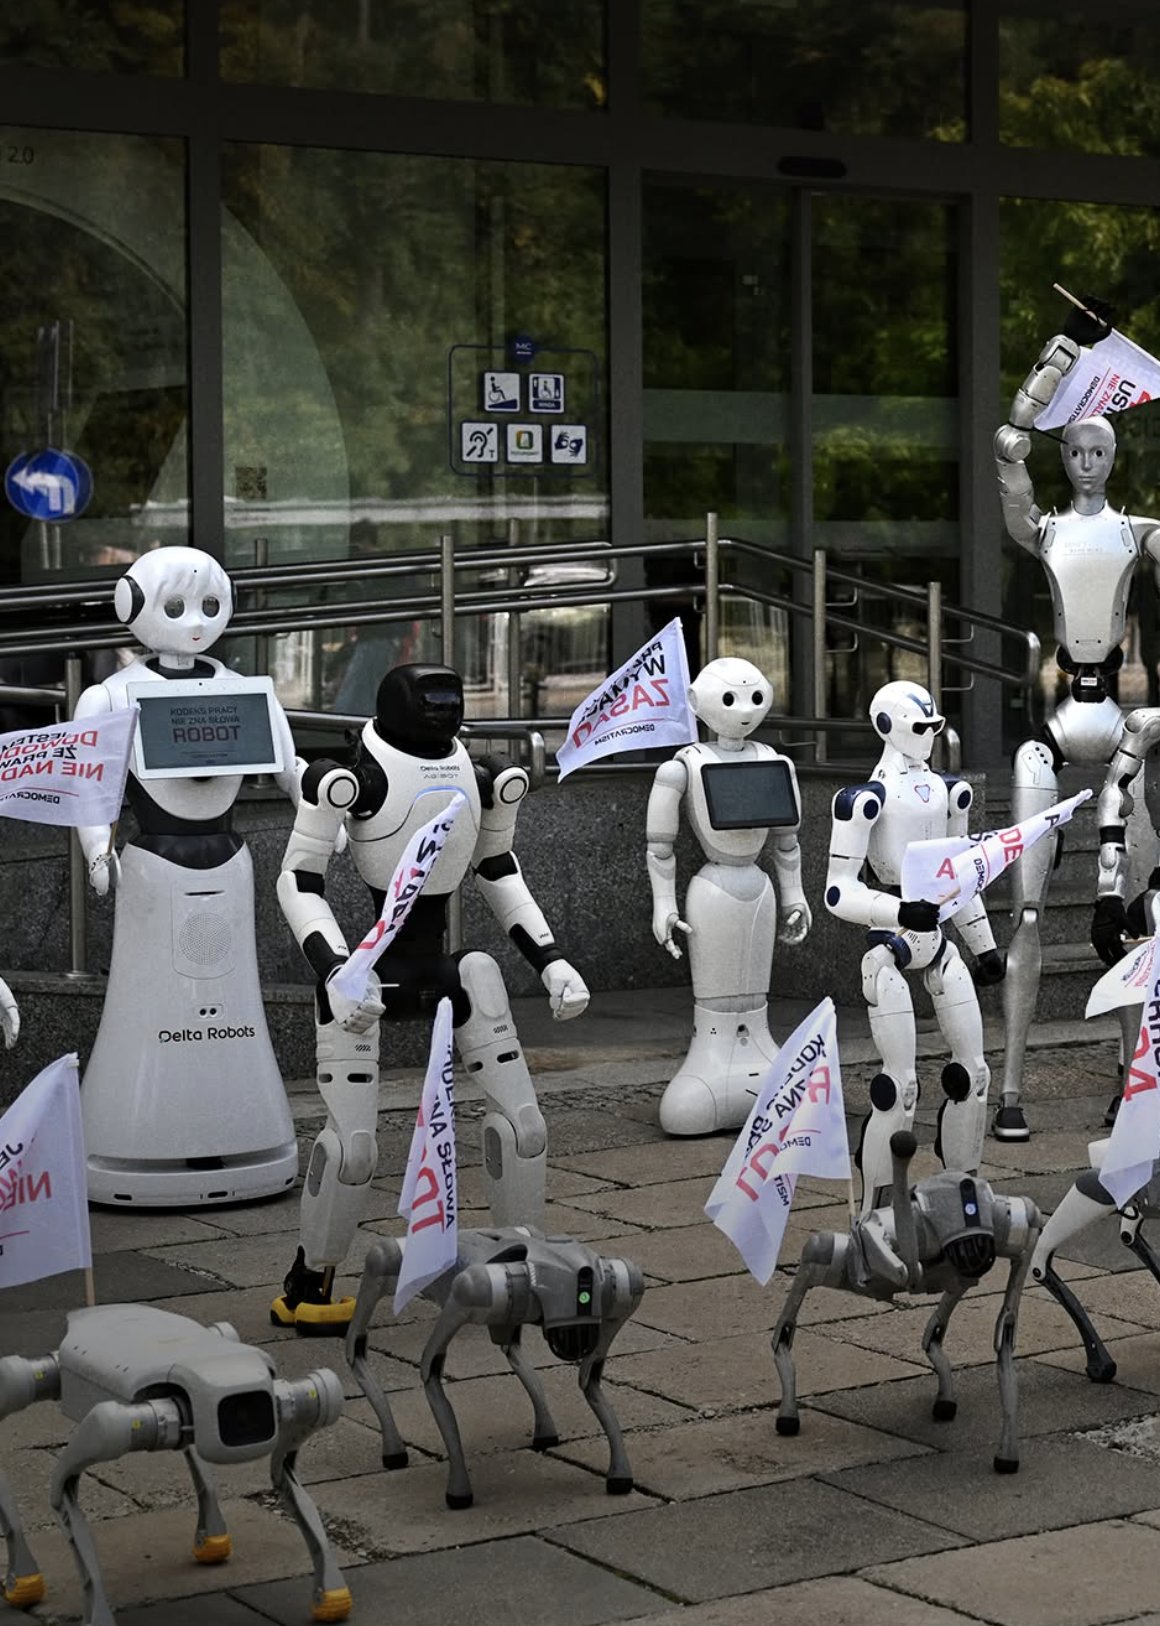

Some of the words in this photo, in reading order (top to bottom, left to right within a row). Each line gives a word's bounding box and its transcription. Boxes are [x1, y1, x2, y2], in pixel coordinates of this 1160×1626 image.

[8, 145, 34, 165] 2.0
[208, 705, 238, 714] PRACY
[172, 725, 241, 743] ROBOT
[158, 1029, 203, 1043] Delta
[207, 1026, 256, 1040] Robots
